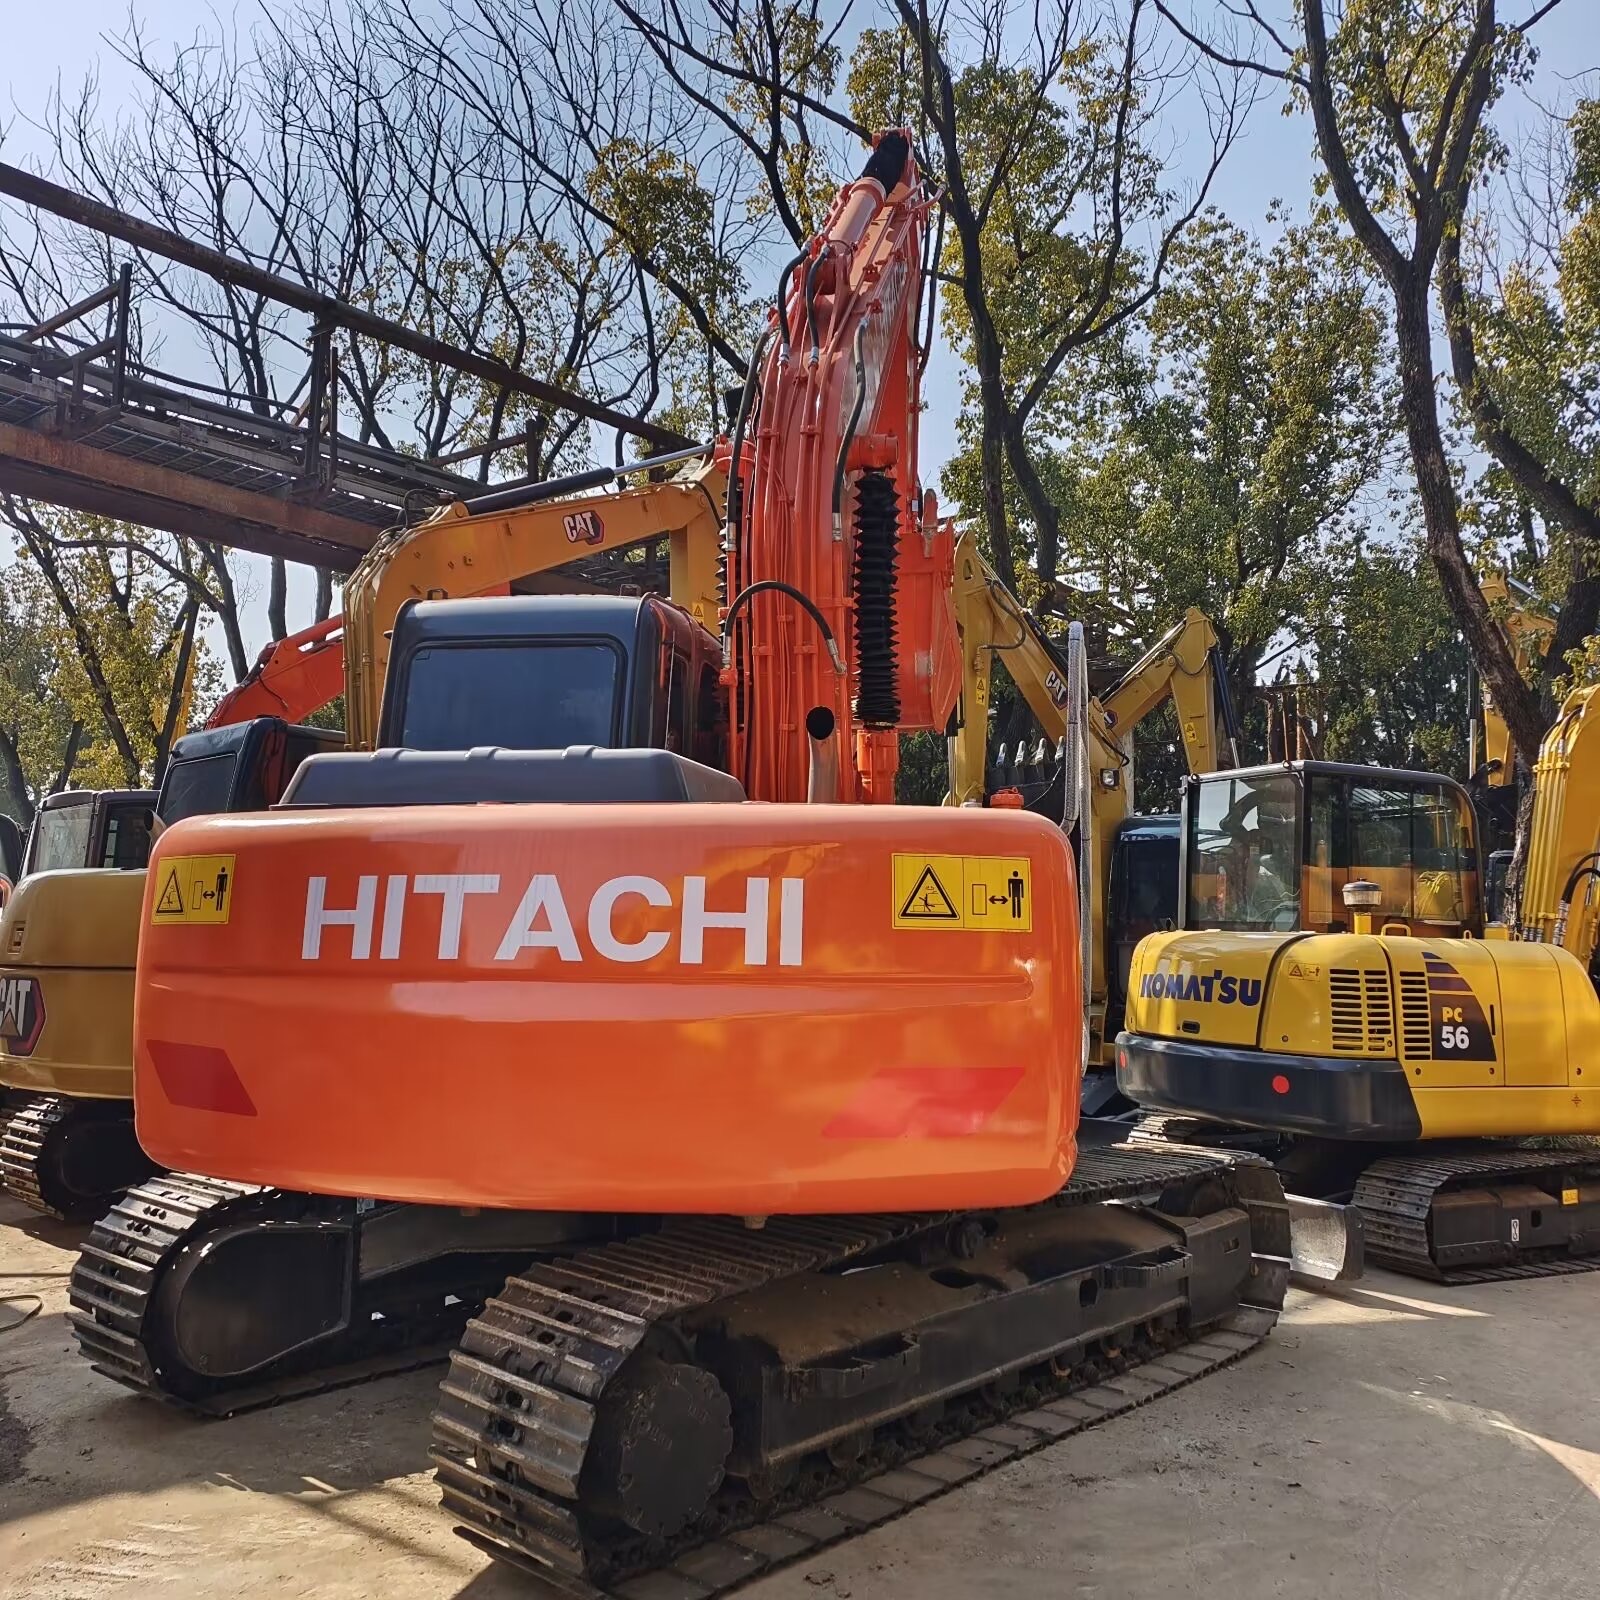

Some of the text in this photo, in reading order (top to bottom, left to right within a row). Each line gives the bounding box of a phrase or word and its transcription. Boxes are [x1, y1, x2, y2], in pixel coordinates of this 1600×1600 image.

[563, 511, 595, 542] CAT
[1045, 670, 1067, 702] CAT
[302, 874, 804, 966] HITACHI
[1140, 969, 1262, 1007] KOMATSU
[1442, 1006, 1463, 1023] PC
[1441, 1025, 1470, 1050] 56
